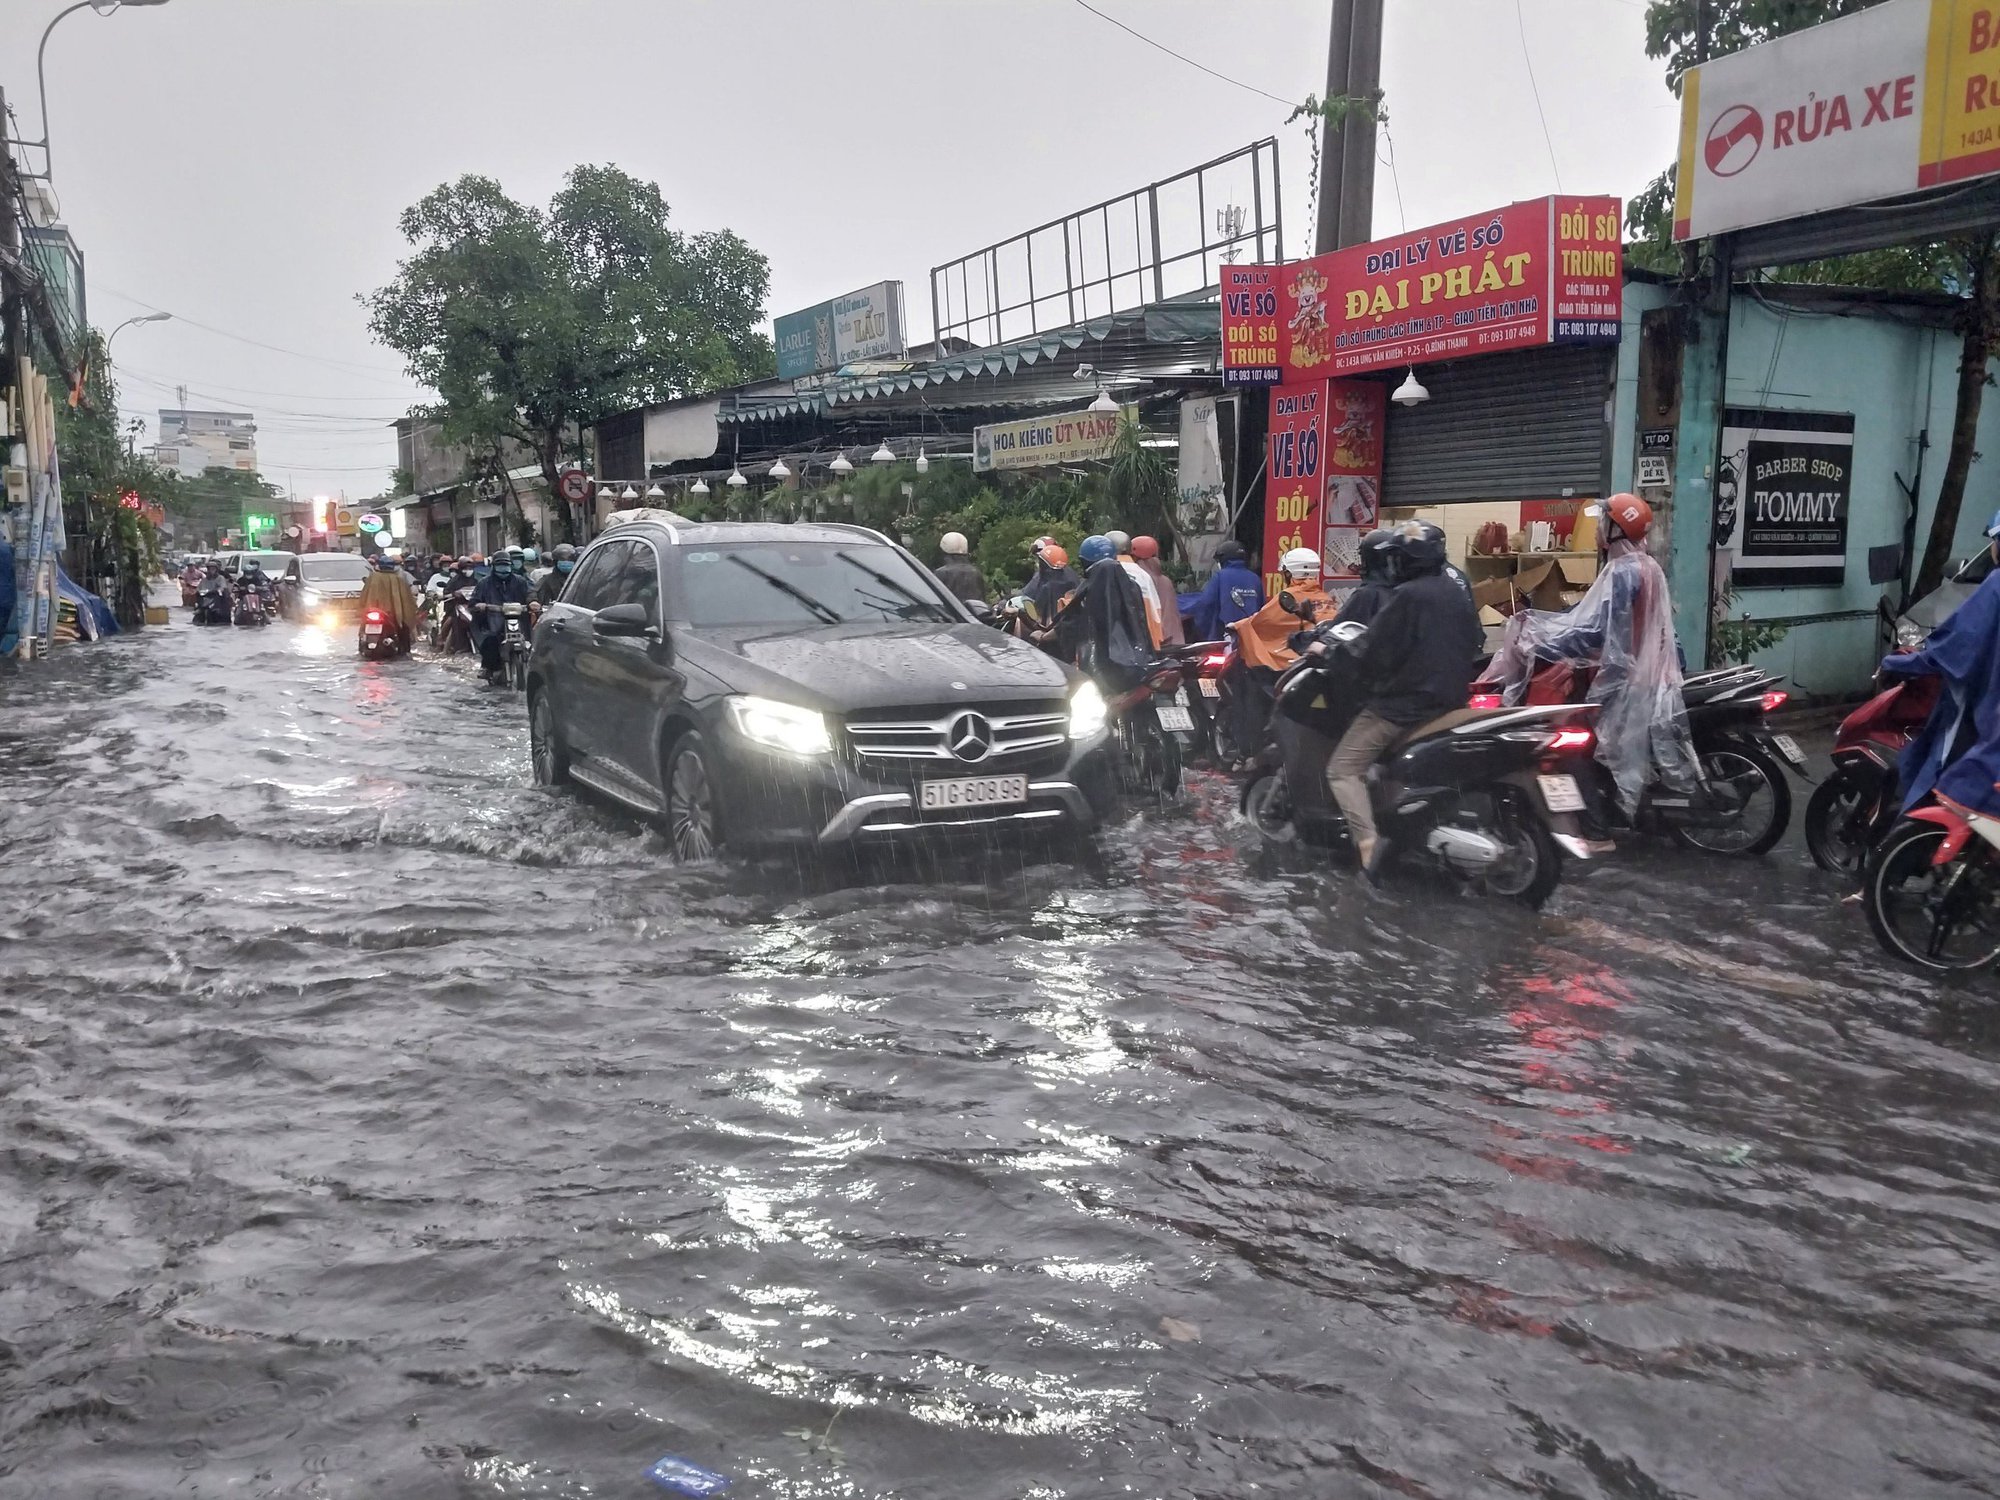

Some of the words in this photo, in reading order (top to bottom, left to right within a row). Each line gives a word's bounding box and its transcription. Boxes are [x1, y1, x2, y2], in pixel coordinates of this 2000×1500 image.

[1773, 91, 1852, 150] RỬA
[1861, 74, 1915, 127] XE
[1961, 127, 1993, 148] 143A
[1560, 202, 1589, 241] ĐỔI
[1595, 205, 1617, 242] SỐ
[1366, 248, 1400, 276] ĐẠI
[1405, 236, 1430, 266] LÝ
[1437, 227, 1466, 258] VÉ
[1472, 215, 1505, 250] SỐ
[1561, 244, 1616, 278] TRÚNG
[1227, 288, 1251, 317] VÉ
[1255, 286, 1277, 317] SỐ
[1345, 279, 1410, 323] ĐẠI
[1419, 250, 1532, 305] PHÁT
[1601, 284, 1610, 297] TP
[1228, 319, 1253, 343] ĐỔI
[1258, 320, 1278, 343] SỐ
[1350, 327, 1360, 346] SỐ
[1362, 325, 1387, 343] TRÚNG
[1388, 321, 1404, 338] CÁC
[1434, 314, 1445, 330] TP
[1453, 308, 1475, 327] GIAO
[1499, 299, 1517, 320] TẬN
[1518, 294, 1538, 315] NHÀ
[1571, 322, 1584, 336] 093
[1585, 322, 1598, 336] 107
[1599, 323, 1617, 336] 4949
[780, 329, 812, 353] LARUE
[1230, 345, 1277, 365] TRÚNG
[1346, 355, 1360, 367] 143A
[1447, 337, 1468, 350] THẠNH
[1491, 330, 1503, 343] 093
[1505, 328, 1517, 340] 107
[1518, 325, 1536, 338] 4949
[1239, 370, 1250, 381] 093
[1251, 369, 1262, 380] 107
[1263, 369, 1278, 380] 4949
[1275, 395, 1299, 417] ĐẠI
[1301, 388, 1319, 413] LÝ
[993, 431, 1016, 451] HOA
[1055, 419, 1073, 444] ÚT
[1076, 414, 1117, 441] VÀNG
[1272, 421, 1295, 479] VÉ
[1296, 414, 1320, 479] SỐ
[1655, 469, 1664, 477] XE
[1755, 457, 1807, 481] BARBER
[1810, 459, 1843, 482] SHOP
[1276, 484, 1309, 522] ĐỔI
[1754, 491, 1841, 522] TOMMY
